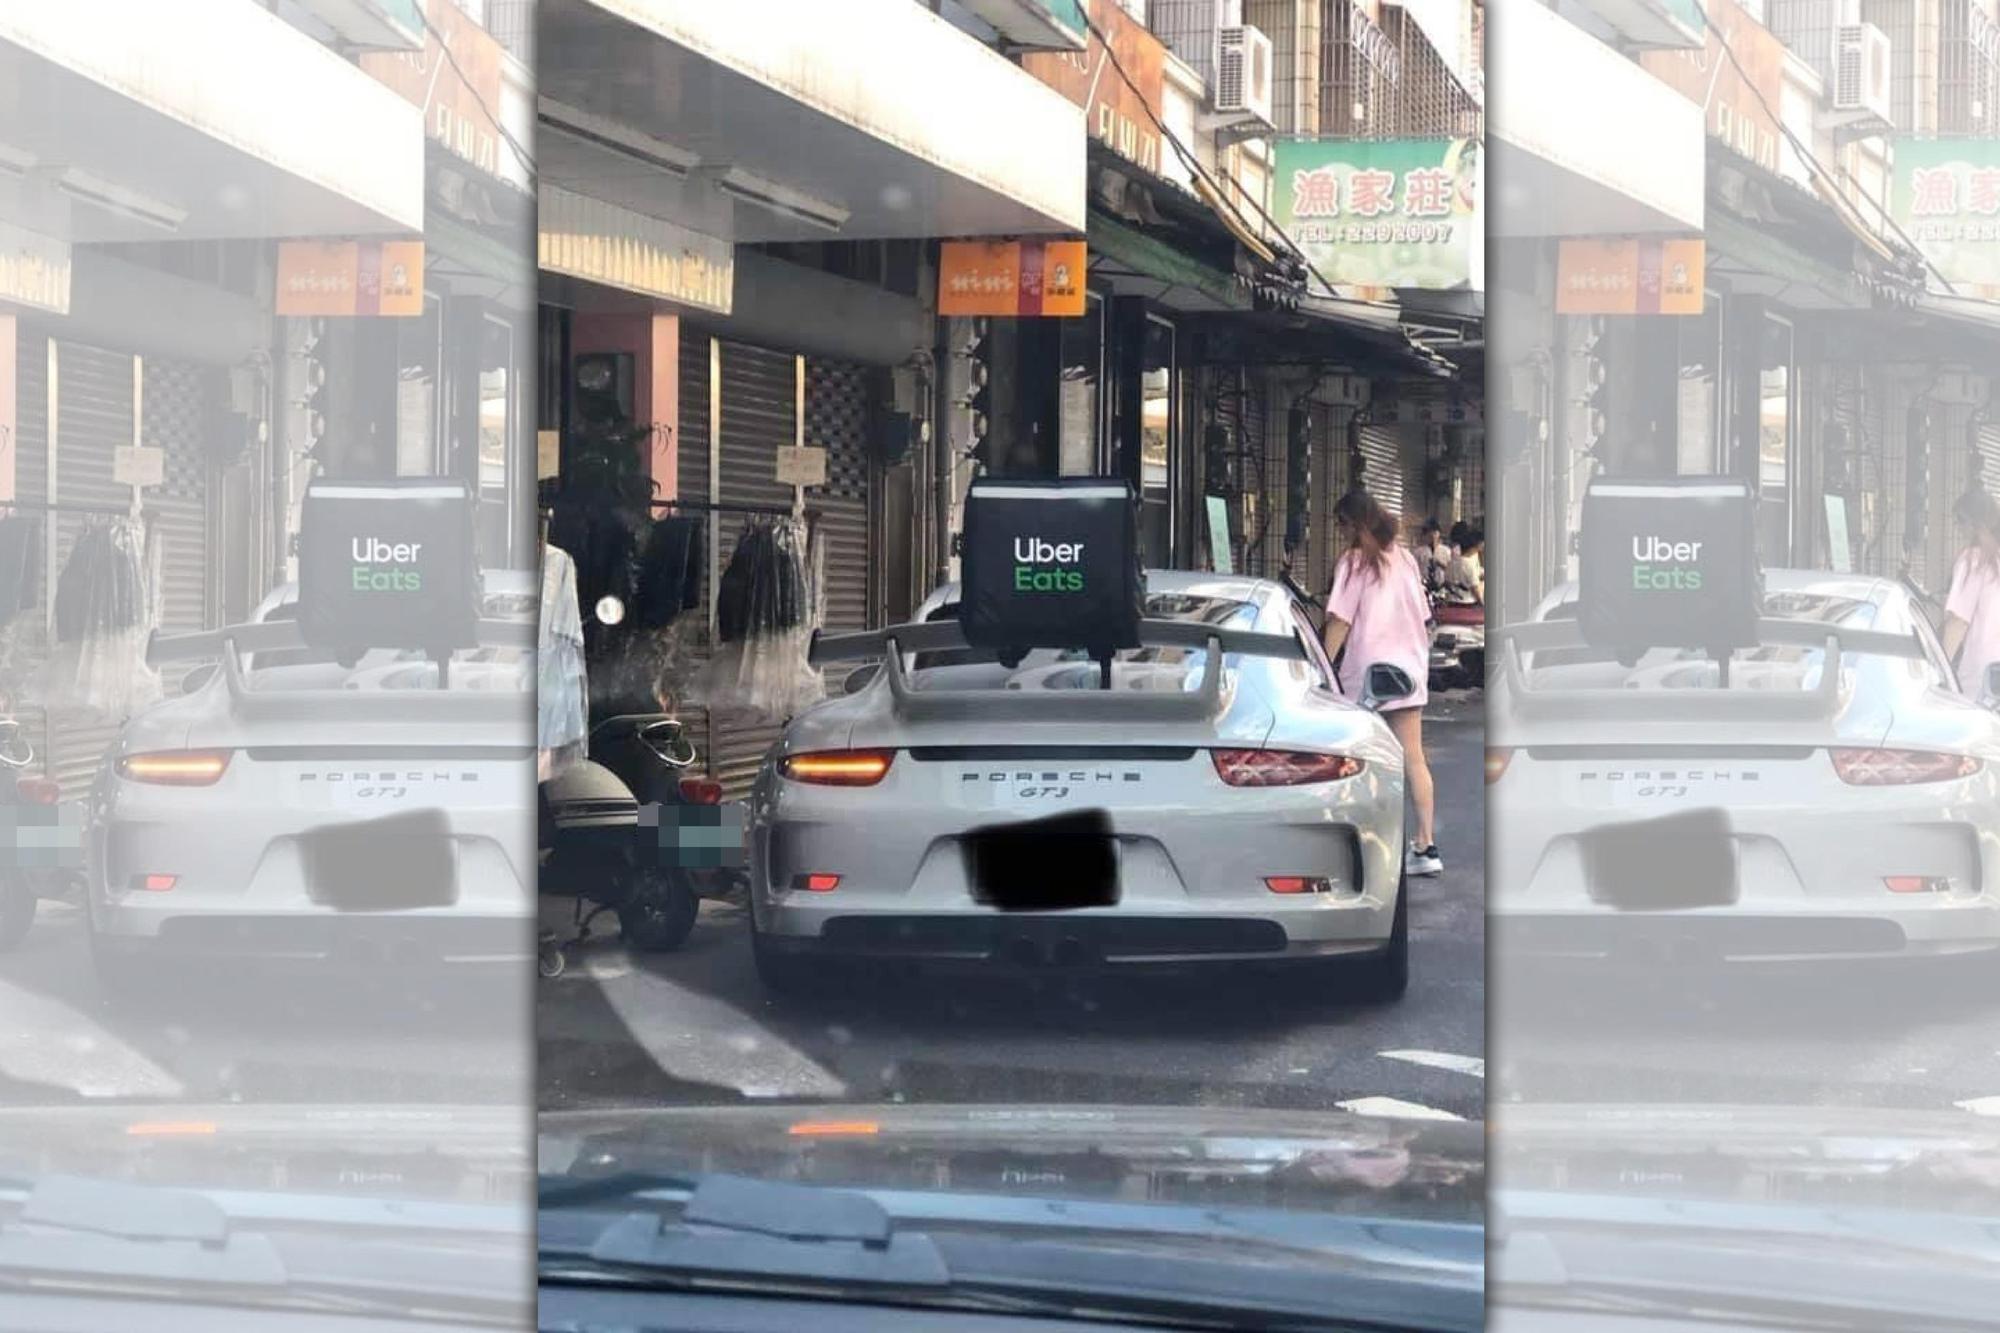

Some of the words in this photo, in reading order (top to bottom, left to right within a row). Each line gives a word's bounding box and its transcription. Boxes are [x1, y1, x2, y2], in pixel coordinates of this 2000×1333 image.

[1294, 168, 1452, 215] 漁家莊
[352, 537, 422, 562] Uber
[1014, 537, 1084, 563] Uber
[1632, 536, 1702, 561] Uber
[352, 566, 422, 591] Eats
[1014, 566, 1084, 591] Eats
[1632, 565, 1702, 590] Eats
[300, 771, 480, 782] PORSCHE
[962, 771, 1142, 782] PORSCHE
[1580, 770, 1760, 781] PORSCHE
[356, 786, 408, 799] GT3
[1019, 786, 1070, 798] GT3
[1637, 785, 1689, 798] GT3
